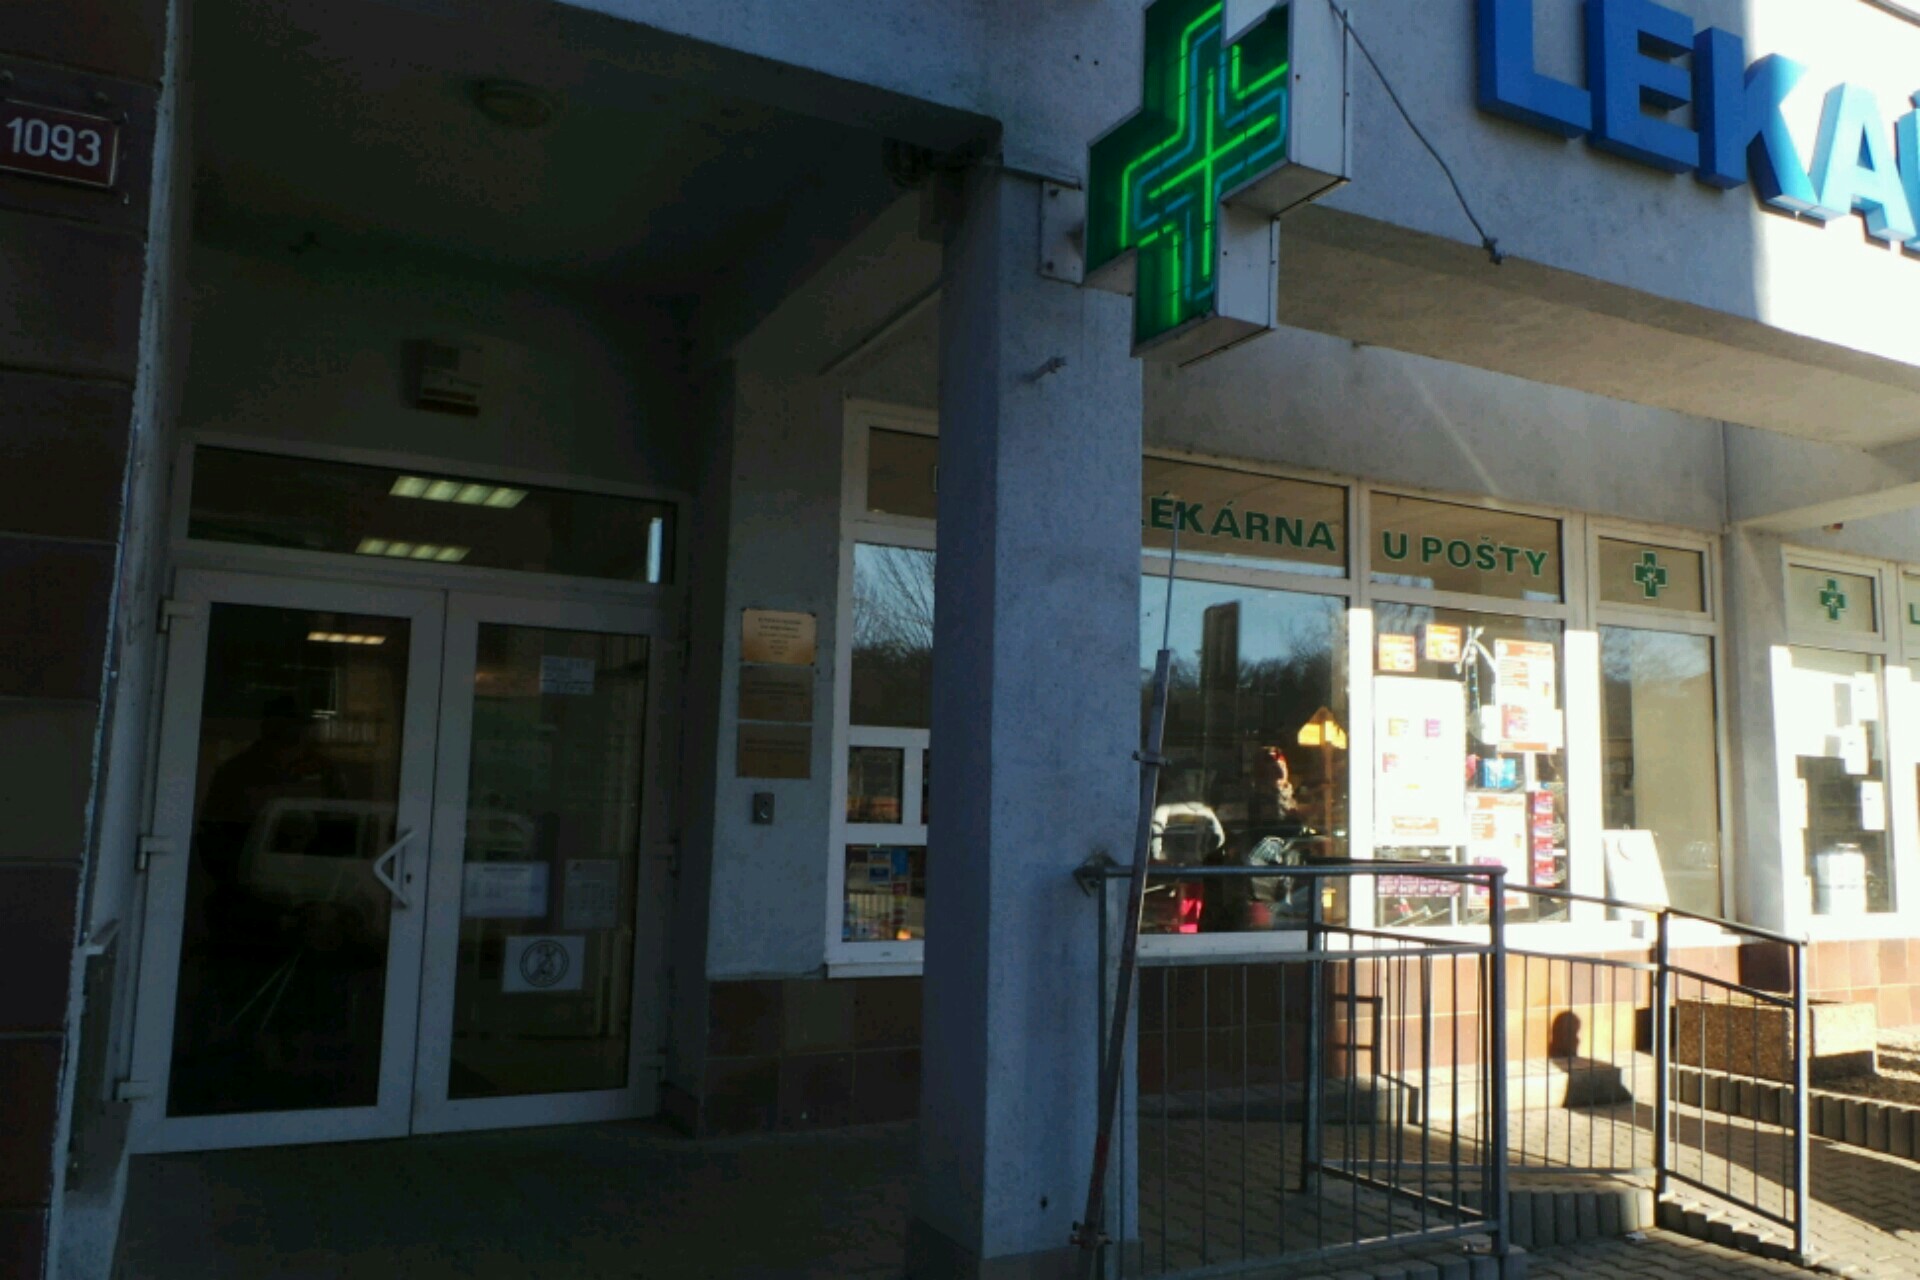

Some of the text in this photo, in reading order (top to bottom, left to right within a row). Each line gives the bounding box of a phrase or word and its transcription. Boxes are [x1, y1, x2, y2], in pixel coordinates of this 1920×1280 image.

[6, 116, 102, 167] 1093
[1141, 490, 1548, 576] ÉKÁRNA U POŠTY
